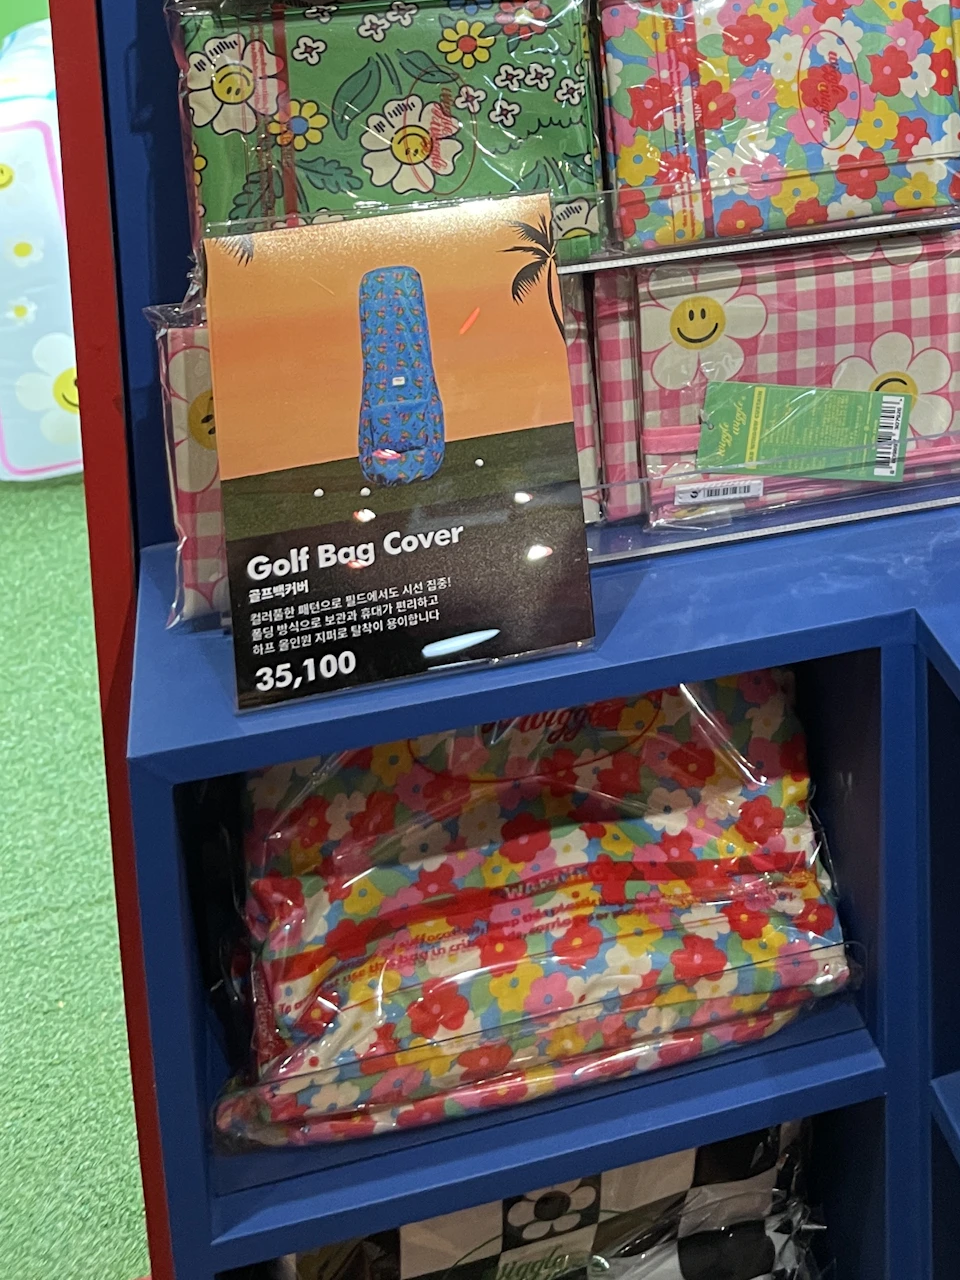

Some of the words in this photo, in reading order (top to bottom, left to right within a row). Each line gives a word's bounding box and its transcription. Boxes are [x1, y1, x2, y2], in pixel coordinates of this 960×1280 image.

[246, 548, 309, 581] Golf
[318, 540, 375, 569] Bag
[383, 524, 465, 556] Cover
[249, 579, 310, 604] 골프백커버
[250, 606, 295, 626] 컬러풀한
[298, 597, 343, 616] 패턴으로
[346, 586, 400, 608] 필드에서도
[402, 581, 424, 596] 시선
[426, 577, 452, 592] 집중!
[251, 626, 274, 642] 폴딩
[277, 617, 322, 636] 방식으로
[325, 609, 358, 626] 보관과
[360, 603, 393, 620] 휴대가
[396, 594, 439, 613] 편리하고
[252, 642, 276, 655] 하프
[315, 627, 349, 643] 지퍼로
[350, 619, 384, 638] 탈착이
[387, 609, 440, 631] 용이합니다
[255, 649, 357, 692] 35,100
